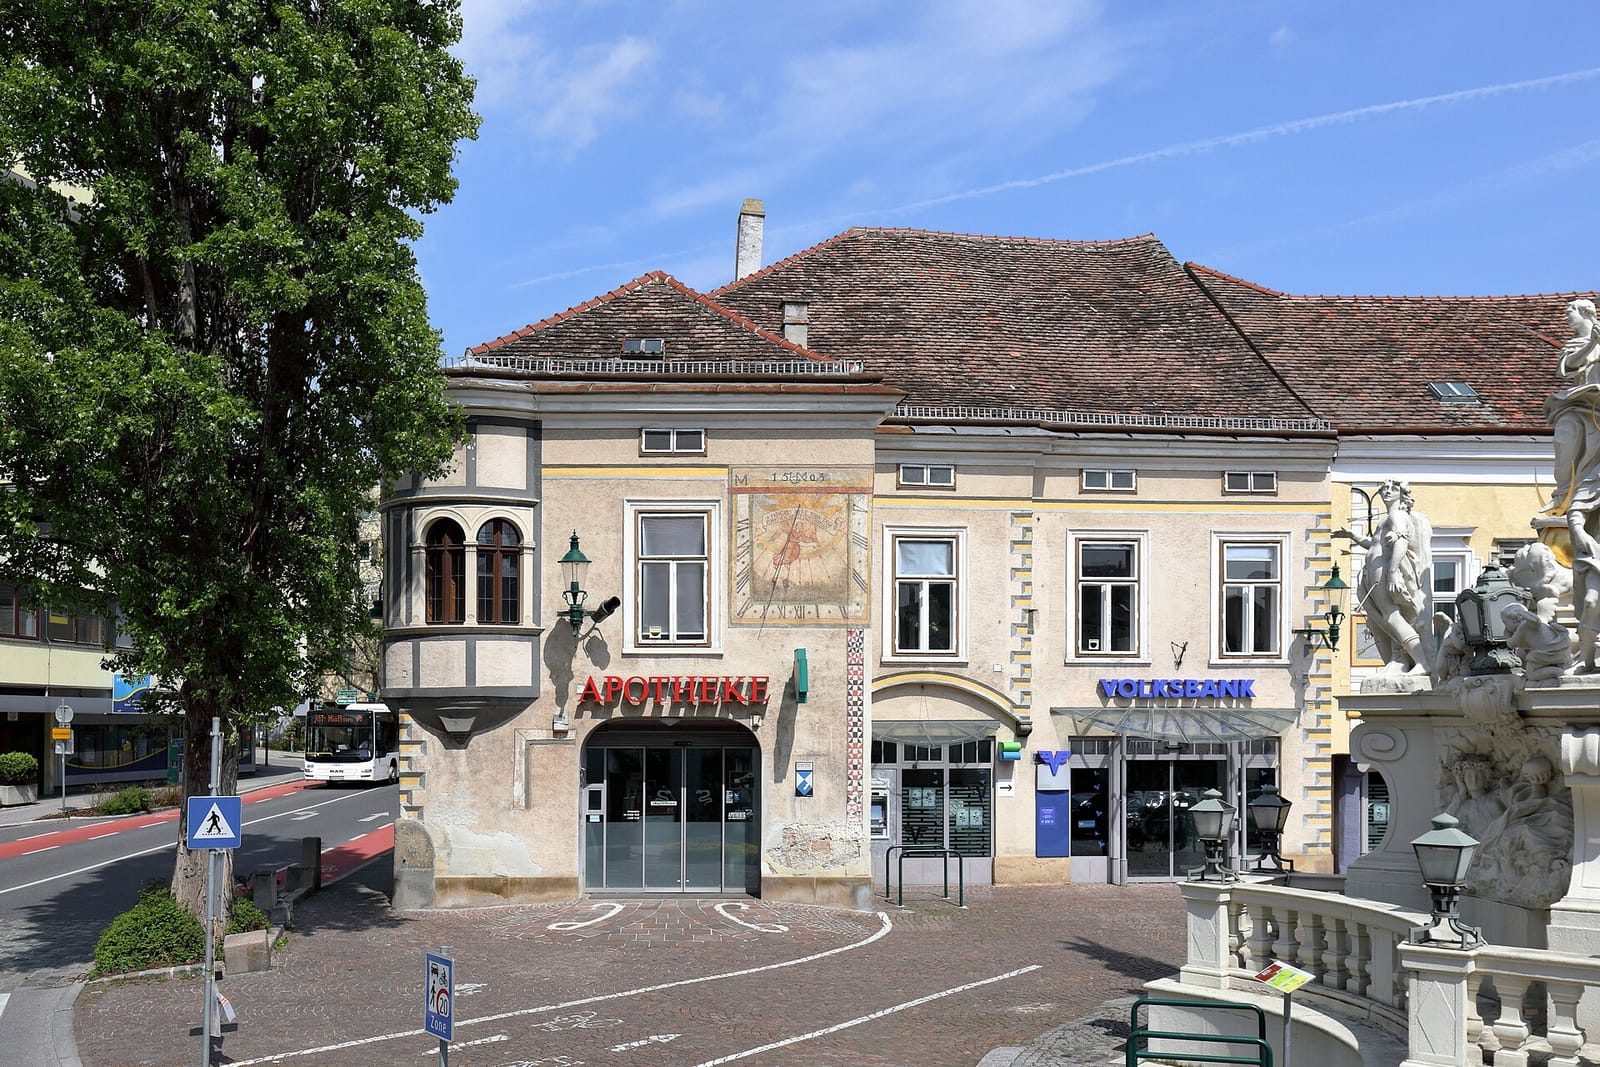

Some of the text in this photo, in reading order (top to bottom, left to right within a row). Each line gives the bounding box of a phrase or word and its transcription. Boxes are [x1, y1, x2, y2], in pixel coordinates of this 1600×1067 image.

[577, 675, 771, 704] APOTHEKE
[1100, 678, 1257, 698] VOLKSBANK
[440, 998, 448, 1015] 20
[430, 1015, 447, 1033] Zone
